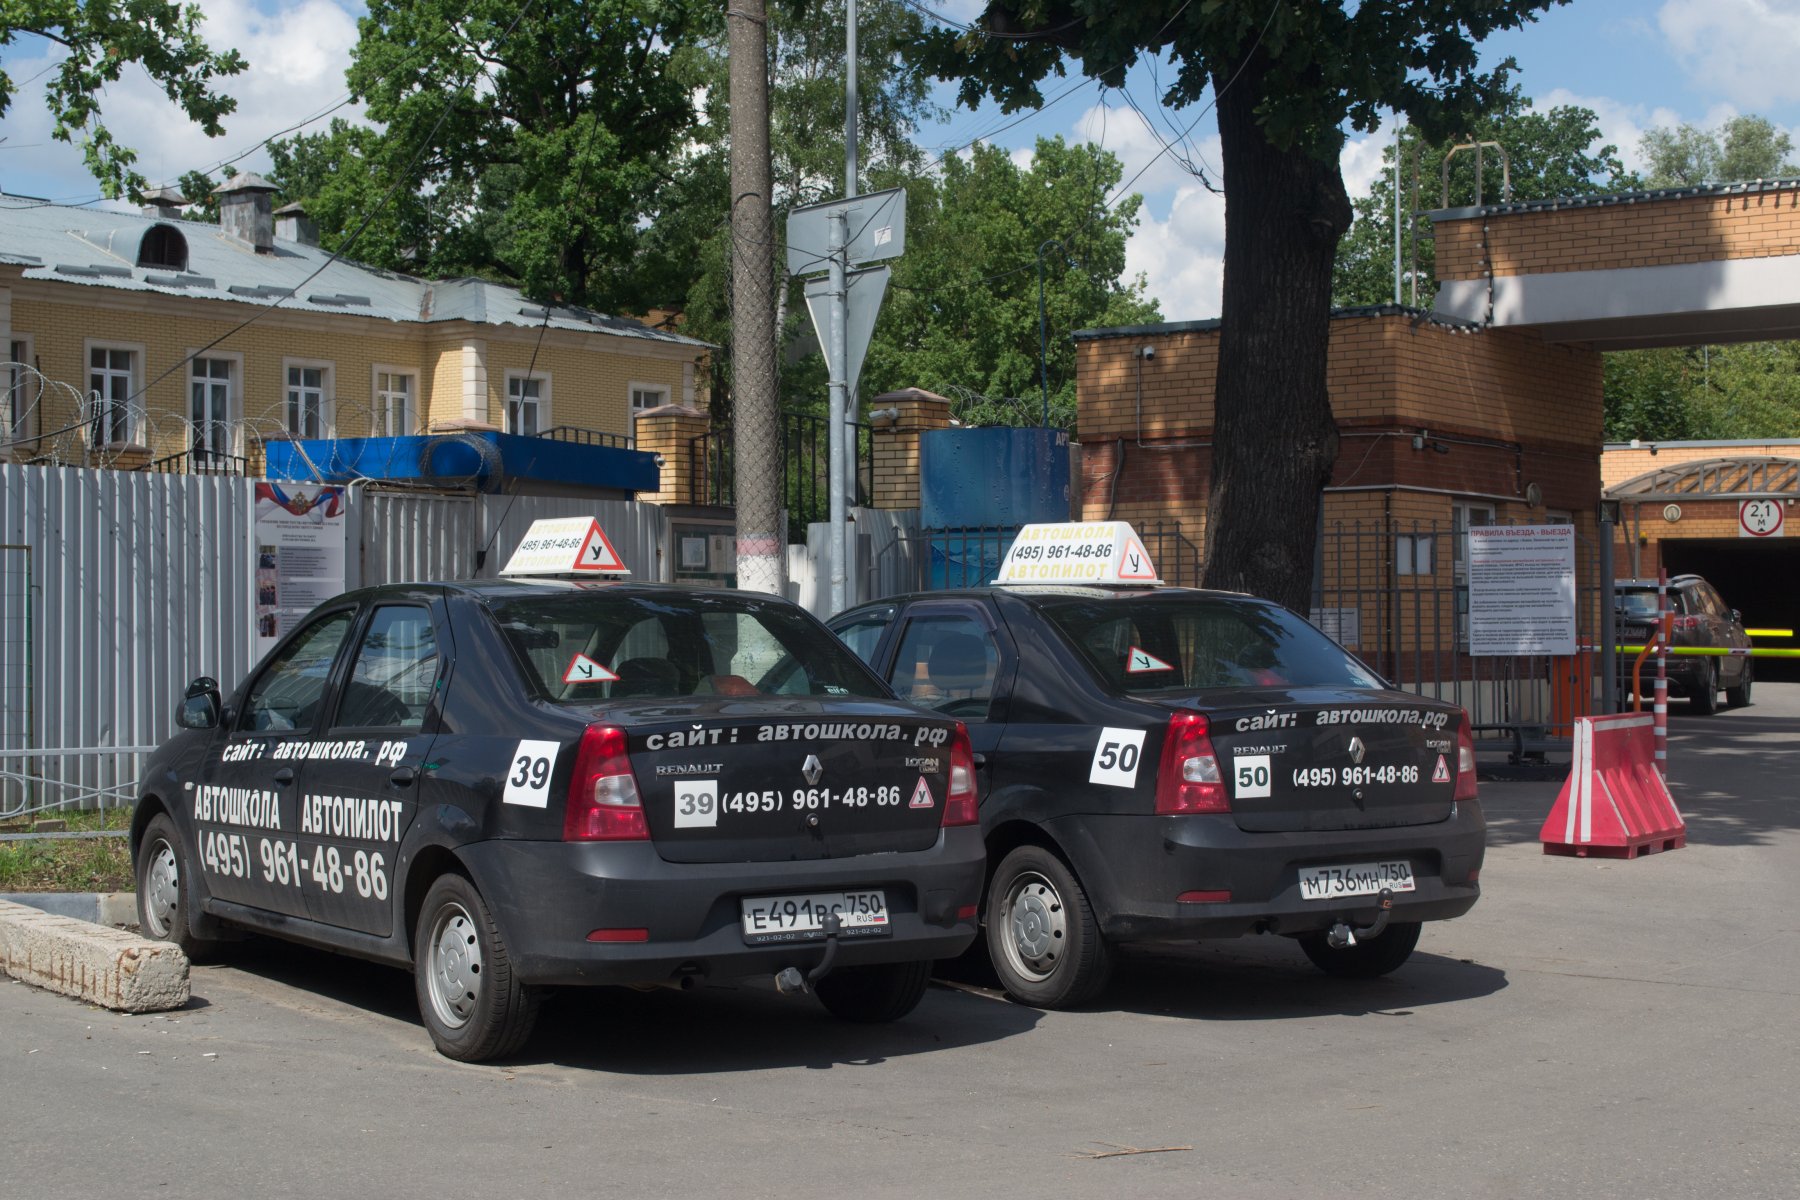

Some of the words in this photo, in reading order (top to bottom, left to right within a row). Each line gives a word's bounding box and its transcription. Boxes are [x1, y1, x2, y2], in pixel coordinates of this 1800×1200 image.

[1750, 504, 1771, 518] 2,1
[1021, 526, 1115, 541] АВТОШКОЛА
[1505, 529, 1535, 537] ВЪЕЗДА
[1540, 528, 1571, 536] ВЫЕЗДА
[518, 540, 541, 553] (495)
[540, 537, 582, 550] 961-48-86
[1011, 545, 1044, 563] (495)
[1047, 544, 1113, 559] 961-48-86
[1006, 563, 1109, 579] АВТОПИЛОТ
[1235, 709, 1298, 732] сайт:
[1316, 709, 1448, 731] автошкола.рф
[222, 739, 266, 762] сайт:
[1098, 741, 1139, 773] 50
[1233, 744, 1288, 755] RENAULT
[656, 763, 724, 775] RENAULT
[905, 757, 939, 767] LOGAN
[511, 755, 550, 790] 39
[1238, 766, 1269, 788] 50
[1292, 767, 1337, 787] (495)
[1342, 765, 1419, 785] 961-48-86
[679, 793, 714, 816] 39
[722, 790, 783, 814] (495)
[792, 786, 900, 810] 961-48-86
[194, 784, 281, 830] АВТОШКОЛА
[302, 794, 403, 842] АВТОПИЛОТ
[198, 829, 251, 879] (495)
[260, 837, 388, 901] 961-48-86
[1380, 863, 1408, 882] 750
[846, 894, 881, 915] 750
[856, 914, 873, 922] RUS
[757, 934, 795, 942] 921-02-02
[846, 927, 882, 935] 921-02-02
